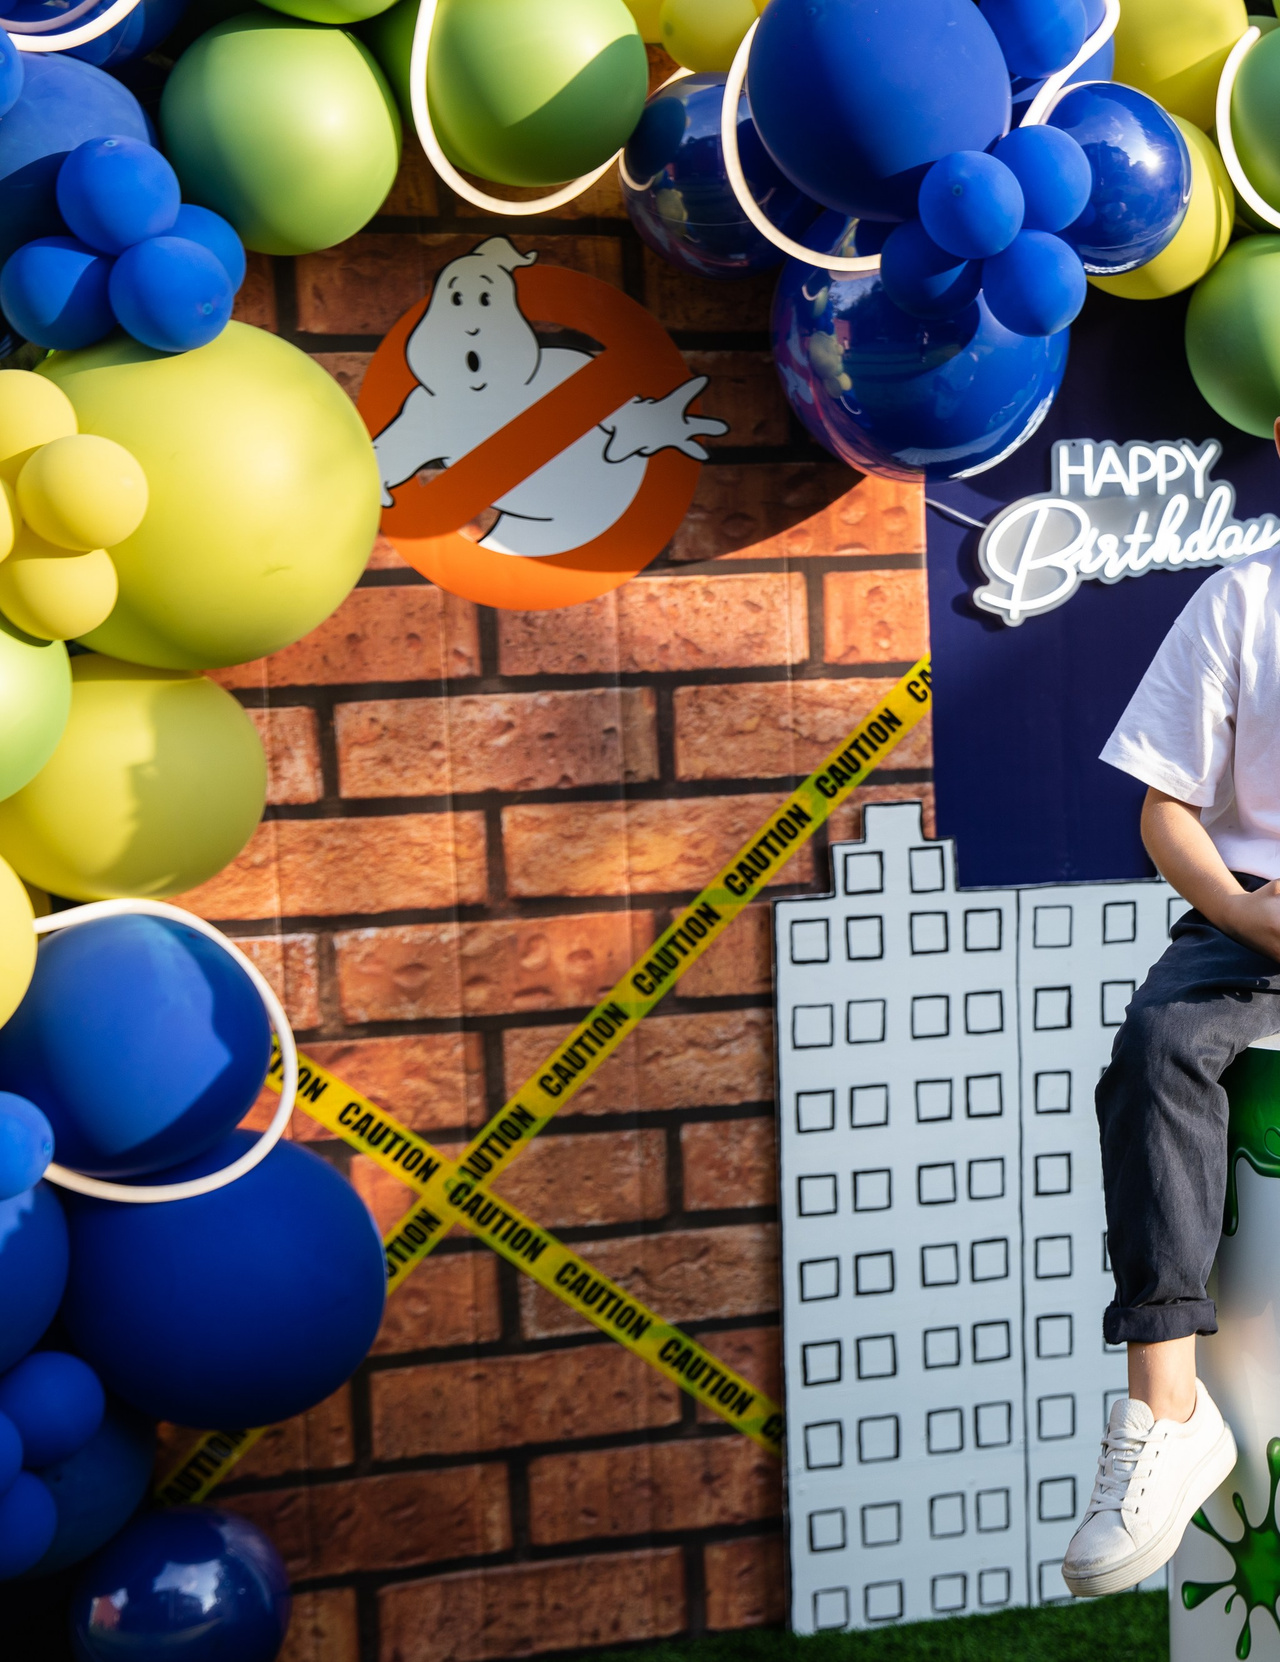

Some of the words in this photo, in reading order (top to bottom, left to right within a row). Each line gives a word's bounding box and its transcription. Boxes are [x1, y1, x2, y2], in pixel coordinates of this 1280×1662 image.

[1059, 444, 1218, 499] HAPPY
[538, 1001, 630, 1098] CAUTION
[632, 901, 722, 997] CAUTION
[723, 803, 813, 897] CAUTION
[814, 707, 904, 799] CAUTION
[338, 1101, 442, 1184] CAUTION
[448, 1182, 550, 1264] CAUTION
[554, 1260, 653, 1341] CAUTION
[657, 1336, 755, 1418] CAUTION
